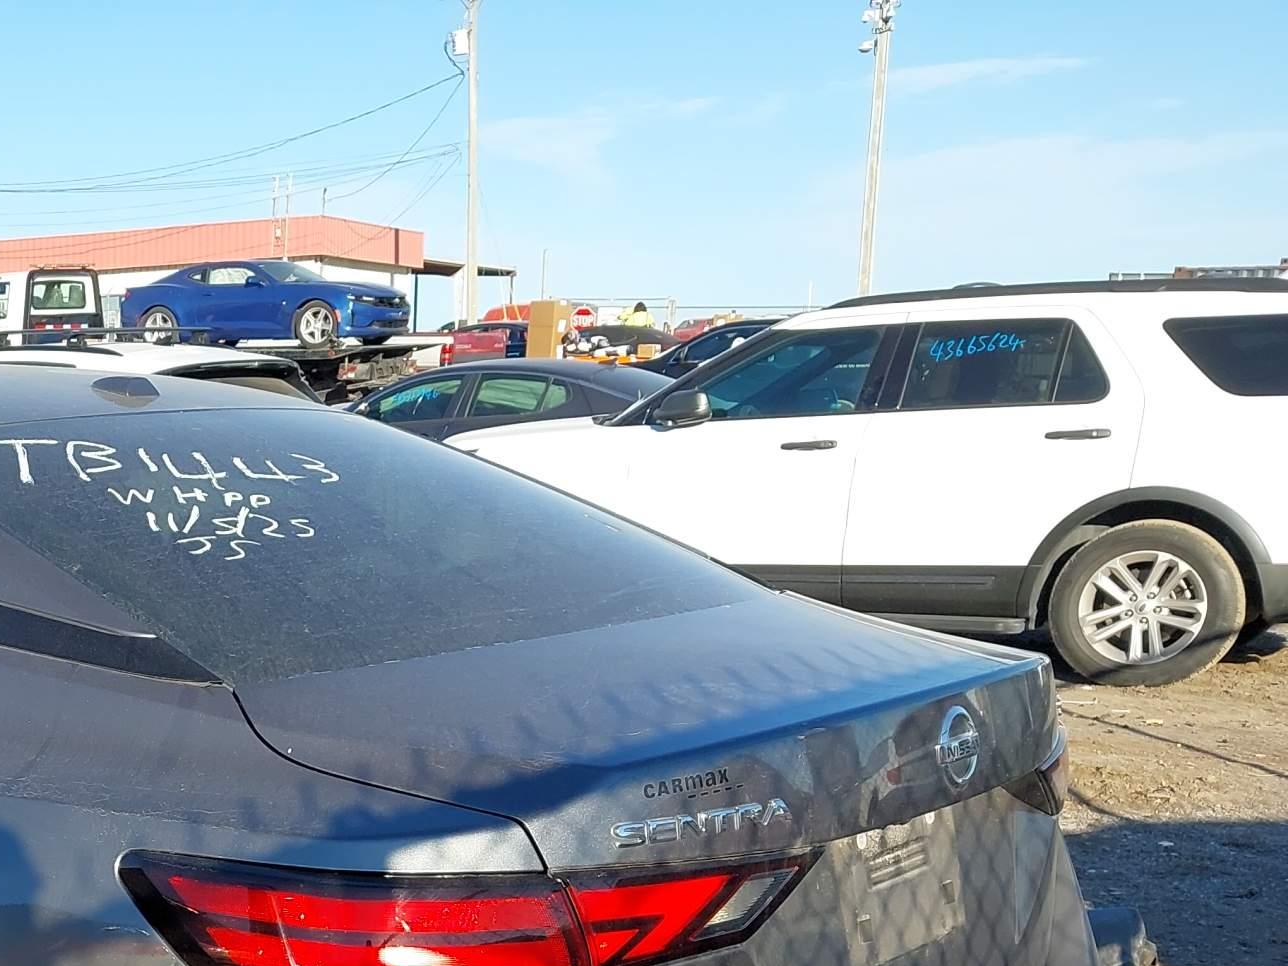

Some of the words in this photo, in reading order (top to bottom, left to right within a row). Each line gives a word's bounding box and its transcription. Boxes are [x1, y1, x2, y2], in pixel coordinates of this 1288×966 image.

[573, 314, 594, 327] STOP
[930, 332, 1024, 362] 43665624
[610, 798, 793, 849] SENTRA
